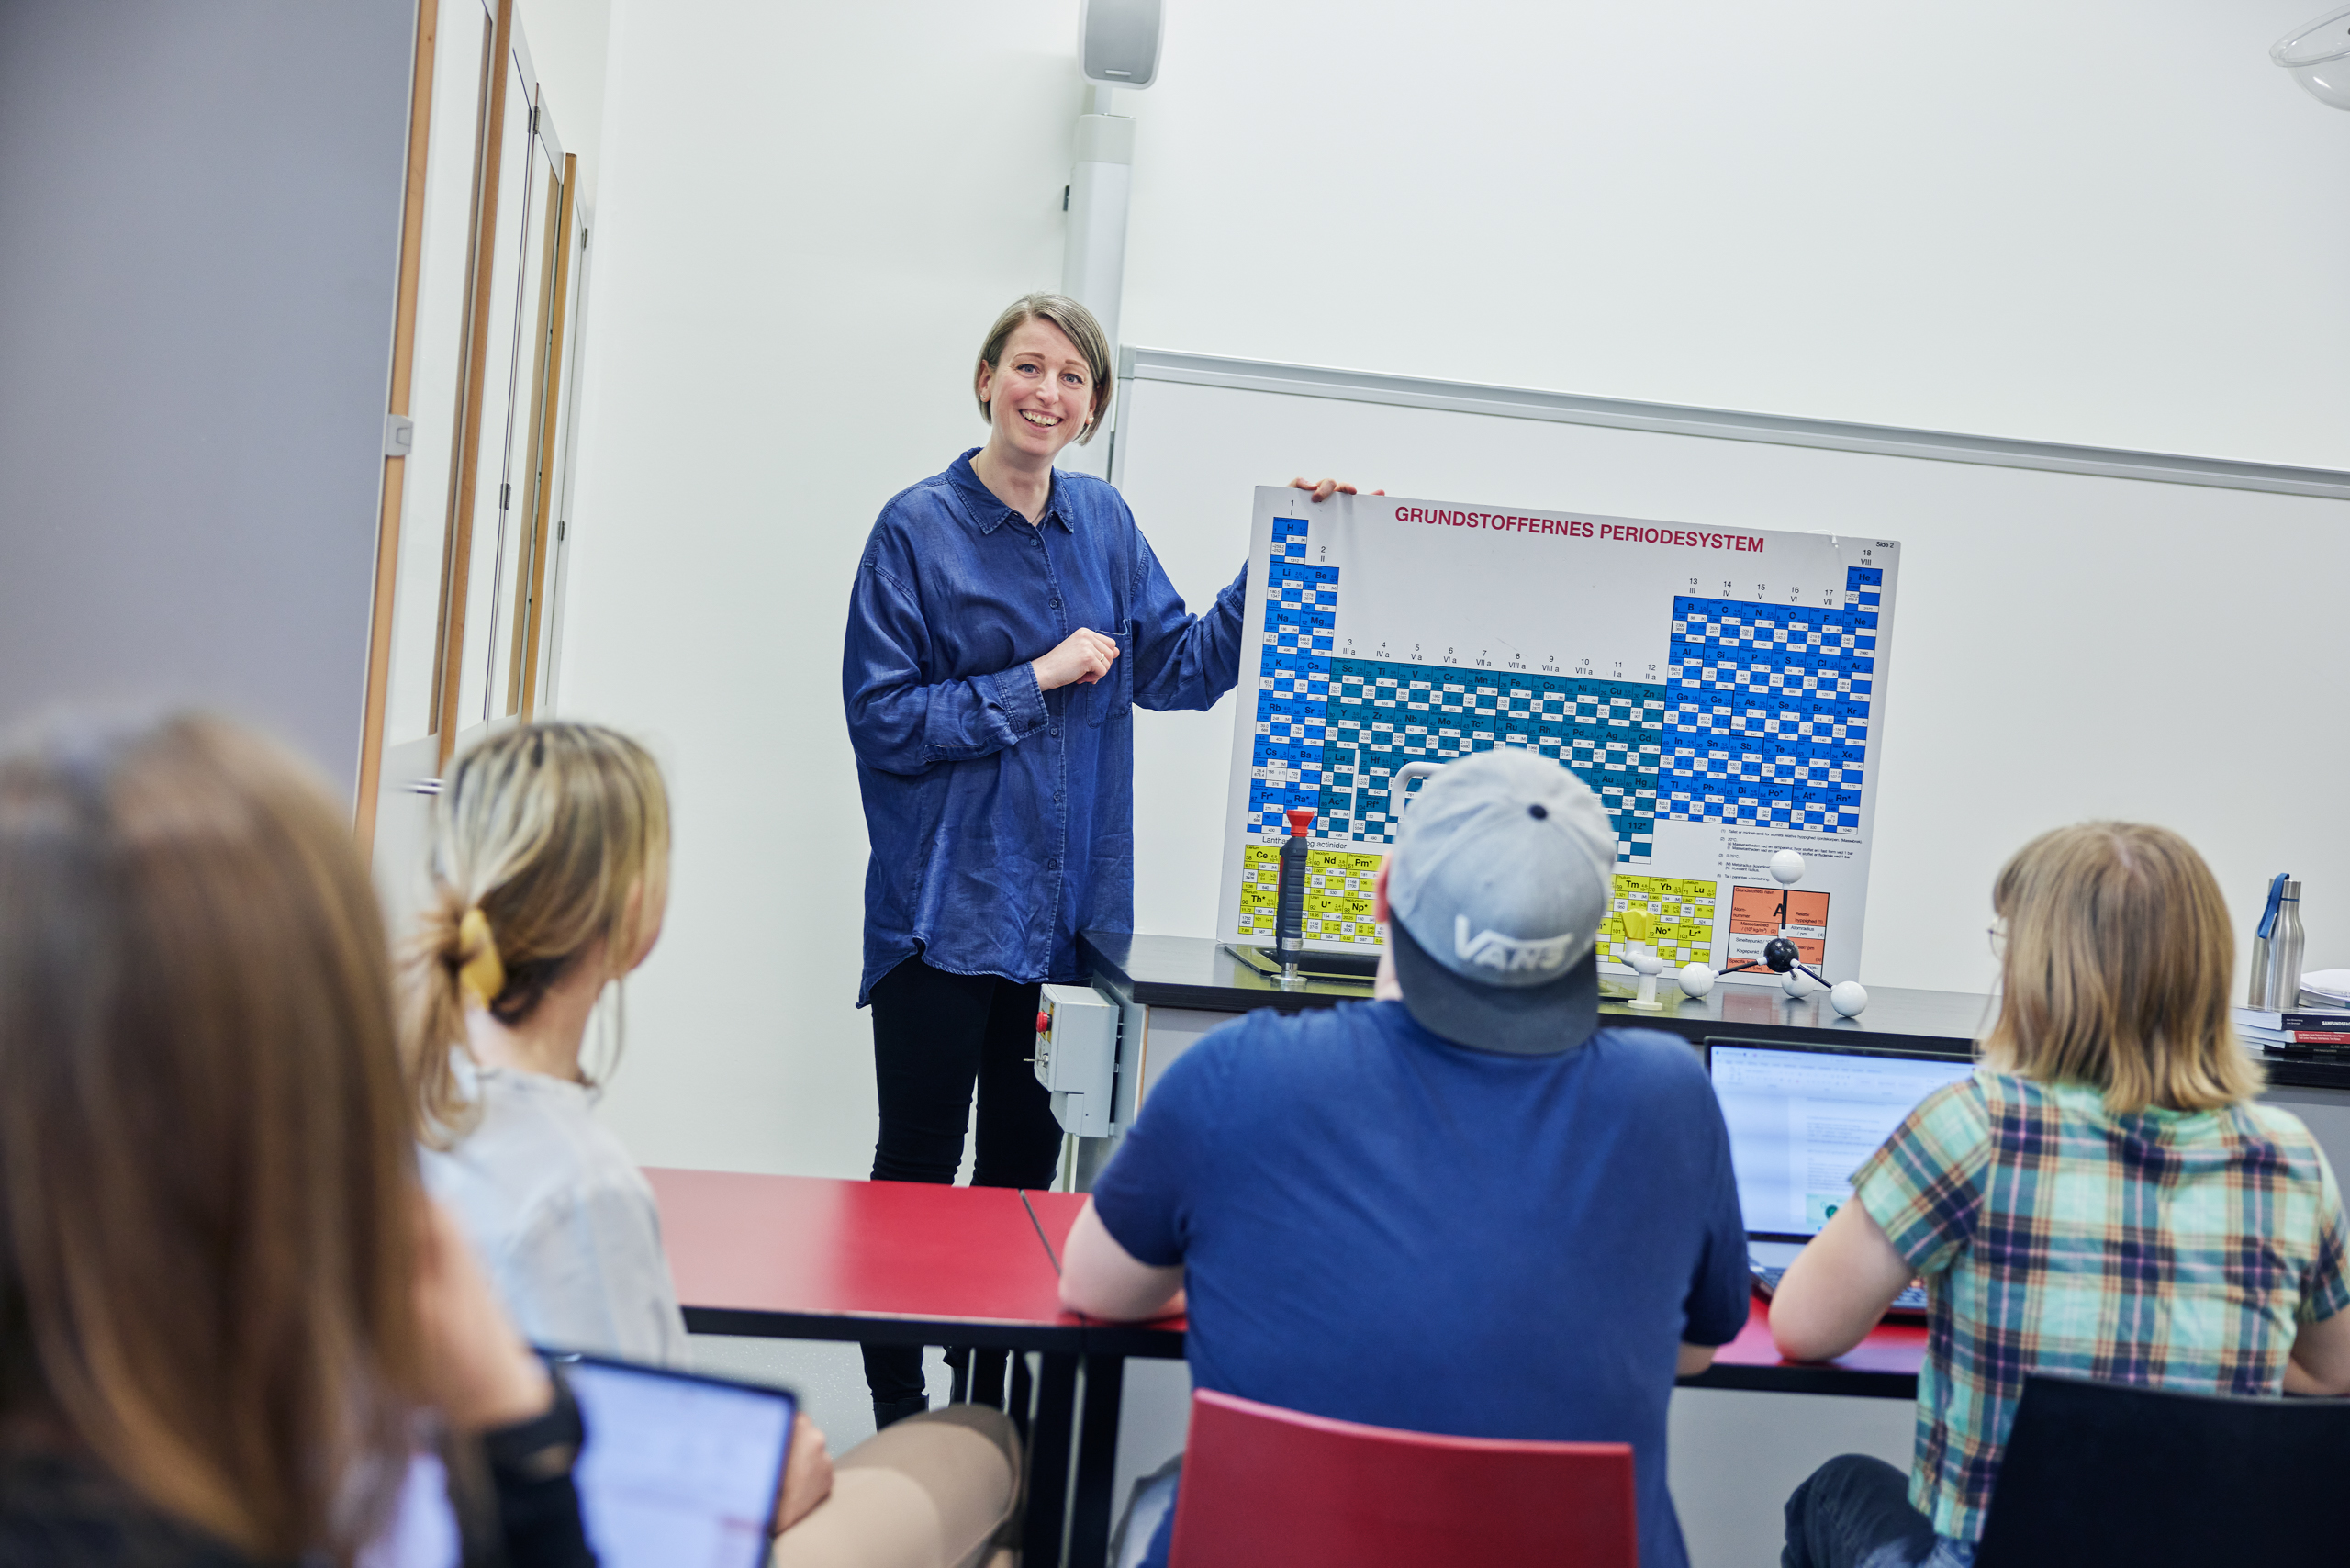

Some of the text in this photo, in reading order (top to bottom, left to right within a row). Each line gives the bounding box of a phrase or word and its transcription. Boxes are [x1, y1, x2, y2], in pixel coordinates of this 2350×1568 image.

[1395, 506, 1764, 553] GRUNDSTOFFERNES PERIODESYSTEM
[1282, 568, 1291, 577] Li
[1315, 571, 1326, 579] Be
[1277, 613, 1289, 622] Na
[1789, 611, 1796, 620] O
[1311, 617, 1324, 626] Mg
[1785, 656, 1791, 665] S
[1818, 659, 1827, 667] Cl
[1307, 662, 1319, 670] Ca
[1342, 665, 1353, 673] Sc
[1378, 667, 1385, 676] Ti
[1443, 673, 1454, 681] Cr
[1474, 676, 1488, 684] Mn
[1510, 678, 1521, 687] Fe
[1543, 681, 1555, 689] Co
[1578, 684, 1587, 692] Ni
[1610, 687, 1622, 695] Cu
[1643, 689, 1654, 698] Zn
[1269, 703, 1281, 711] Rb
[1304, 706, 1315, 714] Sr
[1341, 709, 1348, 717] Y
[1372, 711, 1382, 720] Zr
[1404, 714, 1417, 722] Nb
[1438, 717, 1451, 725] Mo
[1505, 722, 1517, 731] Ru
[1539, 725, 1550, 734] Rh
[1572, 728, 1584, 736] Pd
[1606, 731, 1617, 741] Ag
[1639, 734, 1651, 742] Cd
[1265, 747, 1277, 756] Cs
[1635, 778, 1647, 788] Hg
[1671, 780, 1678, 789] Tl
[1703, 783, 1714, 791] Pb
